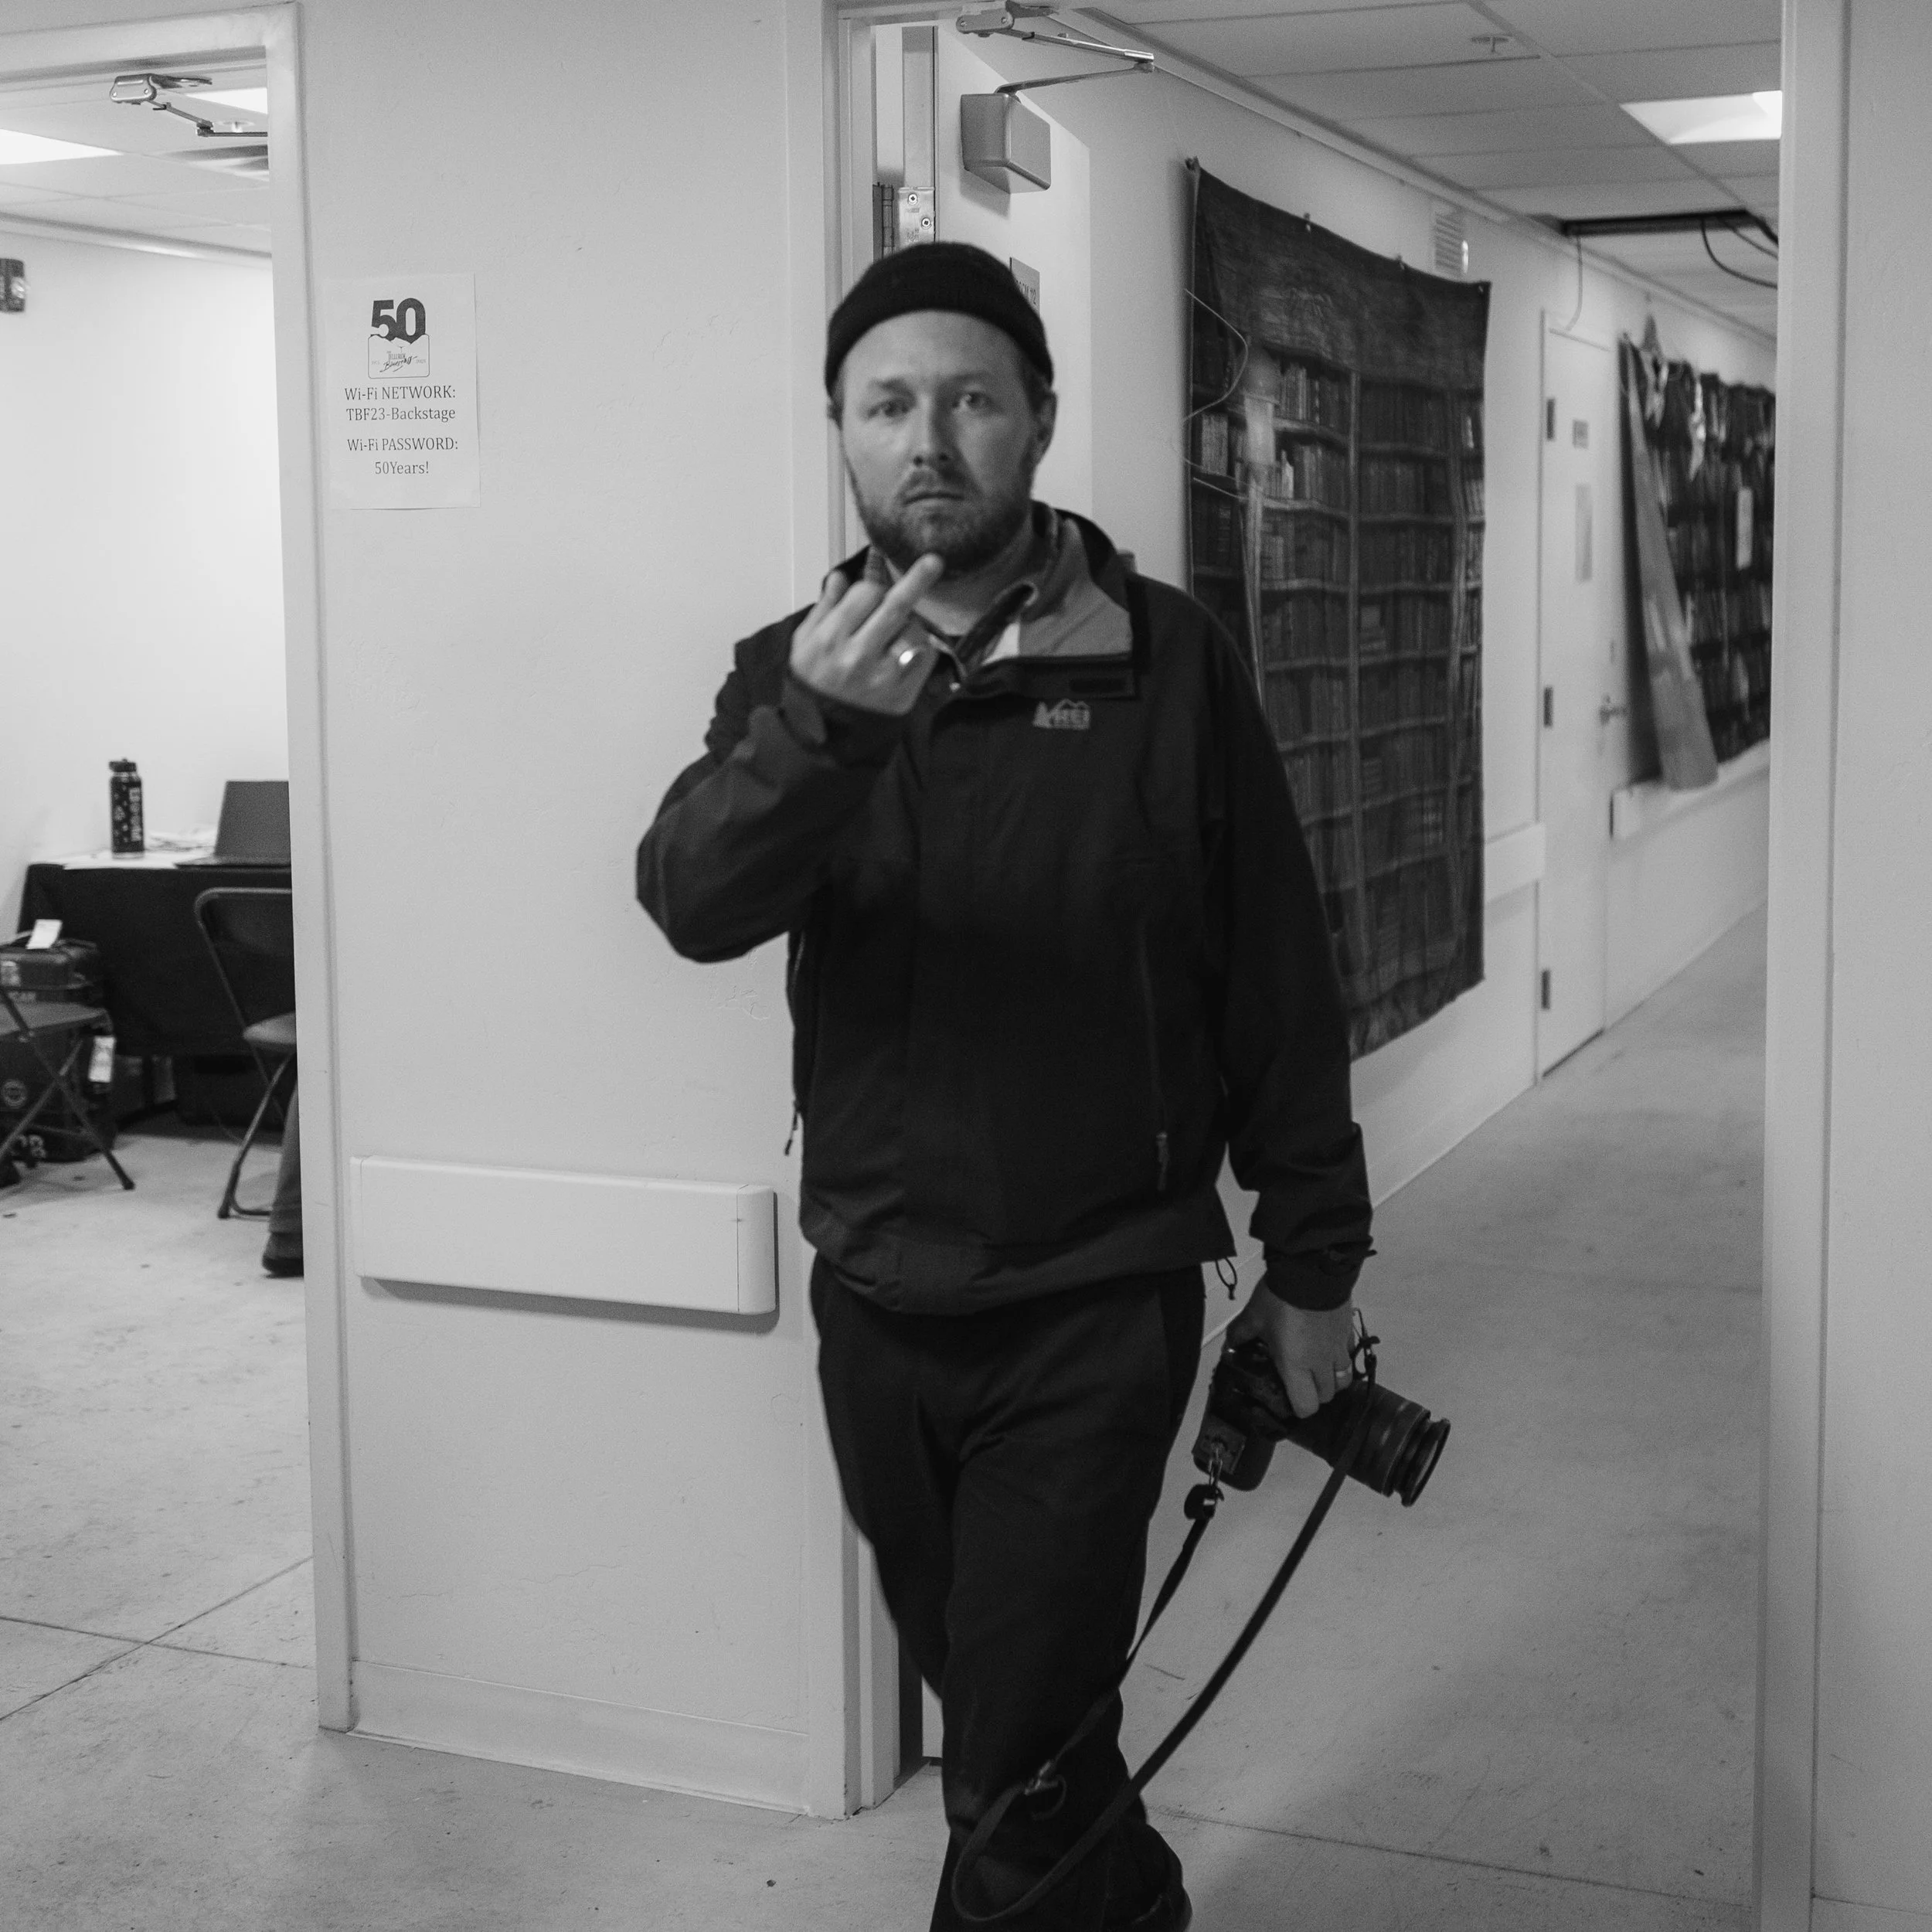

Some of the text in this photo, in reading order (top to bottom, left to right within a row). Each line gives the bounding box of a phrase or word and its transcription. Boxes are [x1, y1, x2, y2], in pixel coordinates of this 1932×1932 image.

[371, 298, 426, 344] 50
[345, 385, 456, 400] Wi-Fi NETWORK:
[345, 406, 456, 423] TBF23-Backstage
[347, 437, 458, 451] Wi-Fi PASSWORD:
[375, 461, 430, 474] 50Years!
